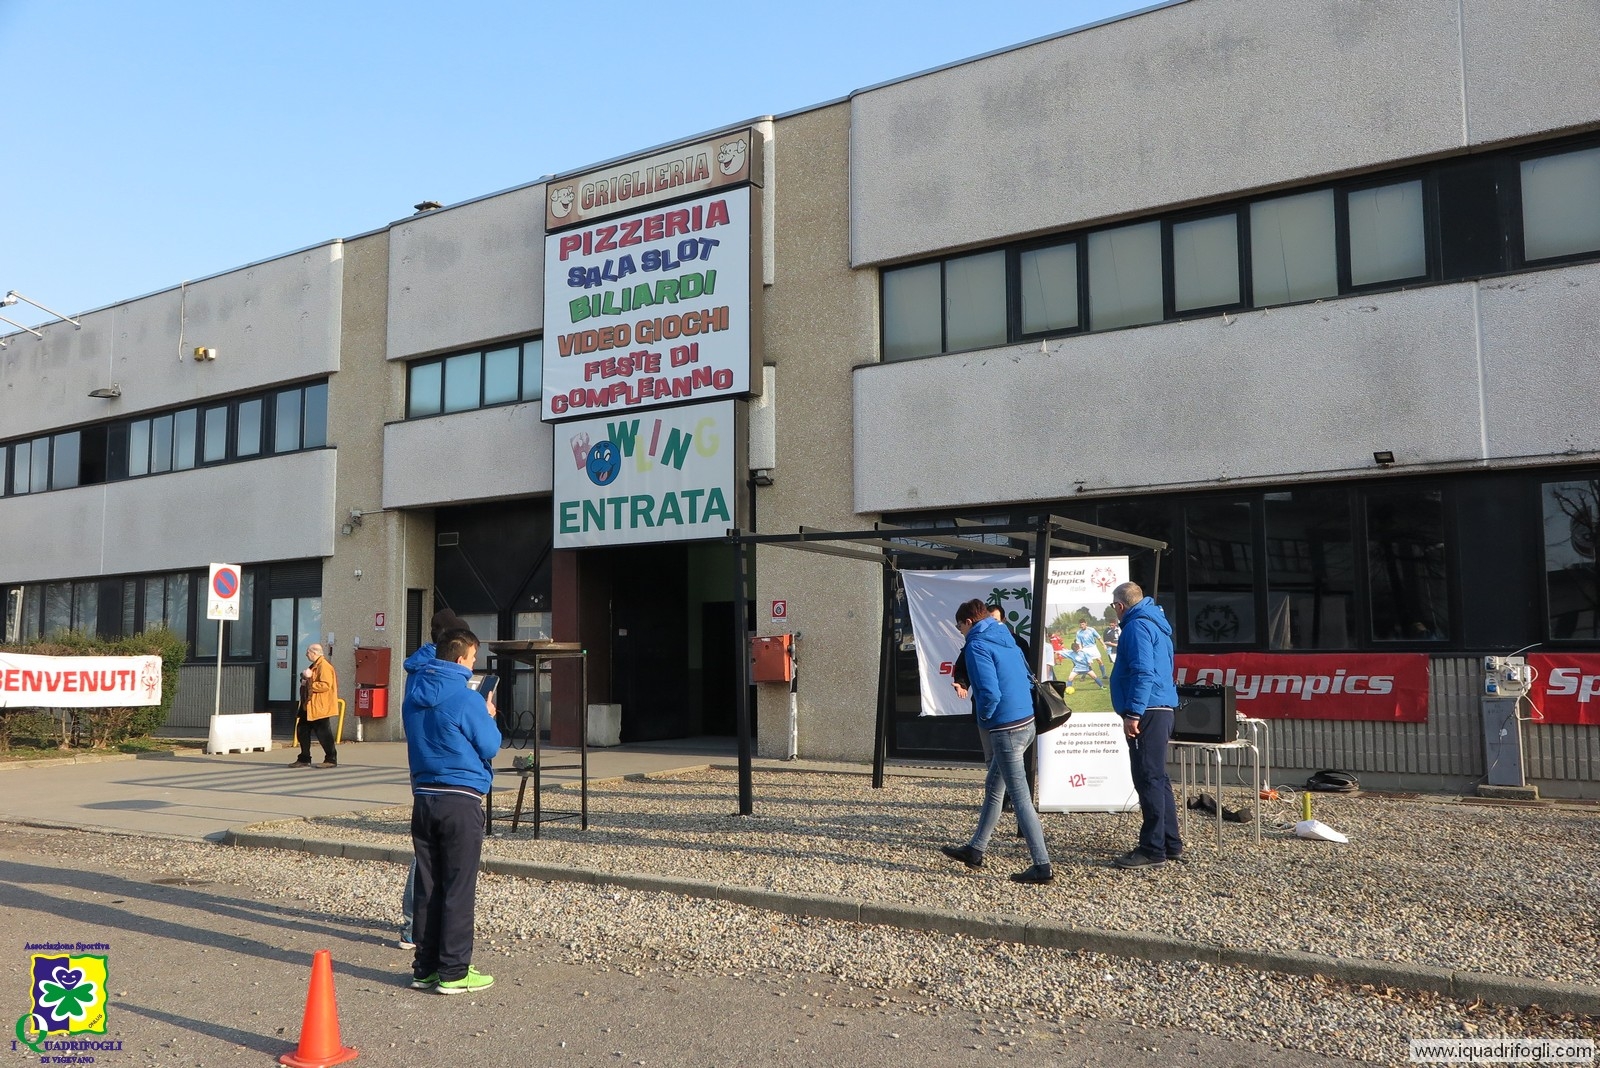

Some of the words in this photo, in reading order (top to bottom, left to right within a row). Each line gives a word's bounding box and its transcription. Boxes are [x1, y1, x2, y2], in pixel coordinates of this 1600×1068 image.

[581, 153, 710, 210] GRIGLIERIA
[559, 199, 730, 261] PIZZERIA
[567, 254, 636, 289] SALA
[641, 237, 720, 272] SLOT
[568, 269, 717, 323] BILIARDI
[557, 323, 631, 357] VIDEO
[635, 306, 729, 344] GIOCHI
[584, 350, 661, 382] FESTE
[670, 342, 699, 368] DI
[551, 365, 733, 414] COMPLEANNO
[560, 487, 730, 534] ENTRATA
[1051, 569, 1085, 577] Special
[0, 669, 136, 692] ENVENUTI
[1196, 668, 1394, 701] Olympics
